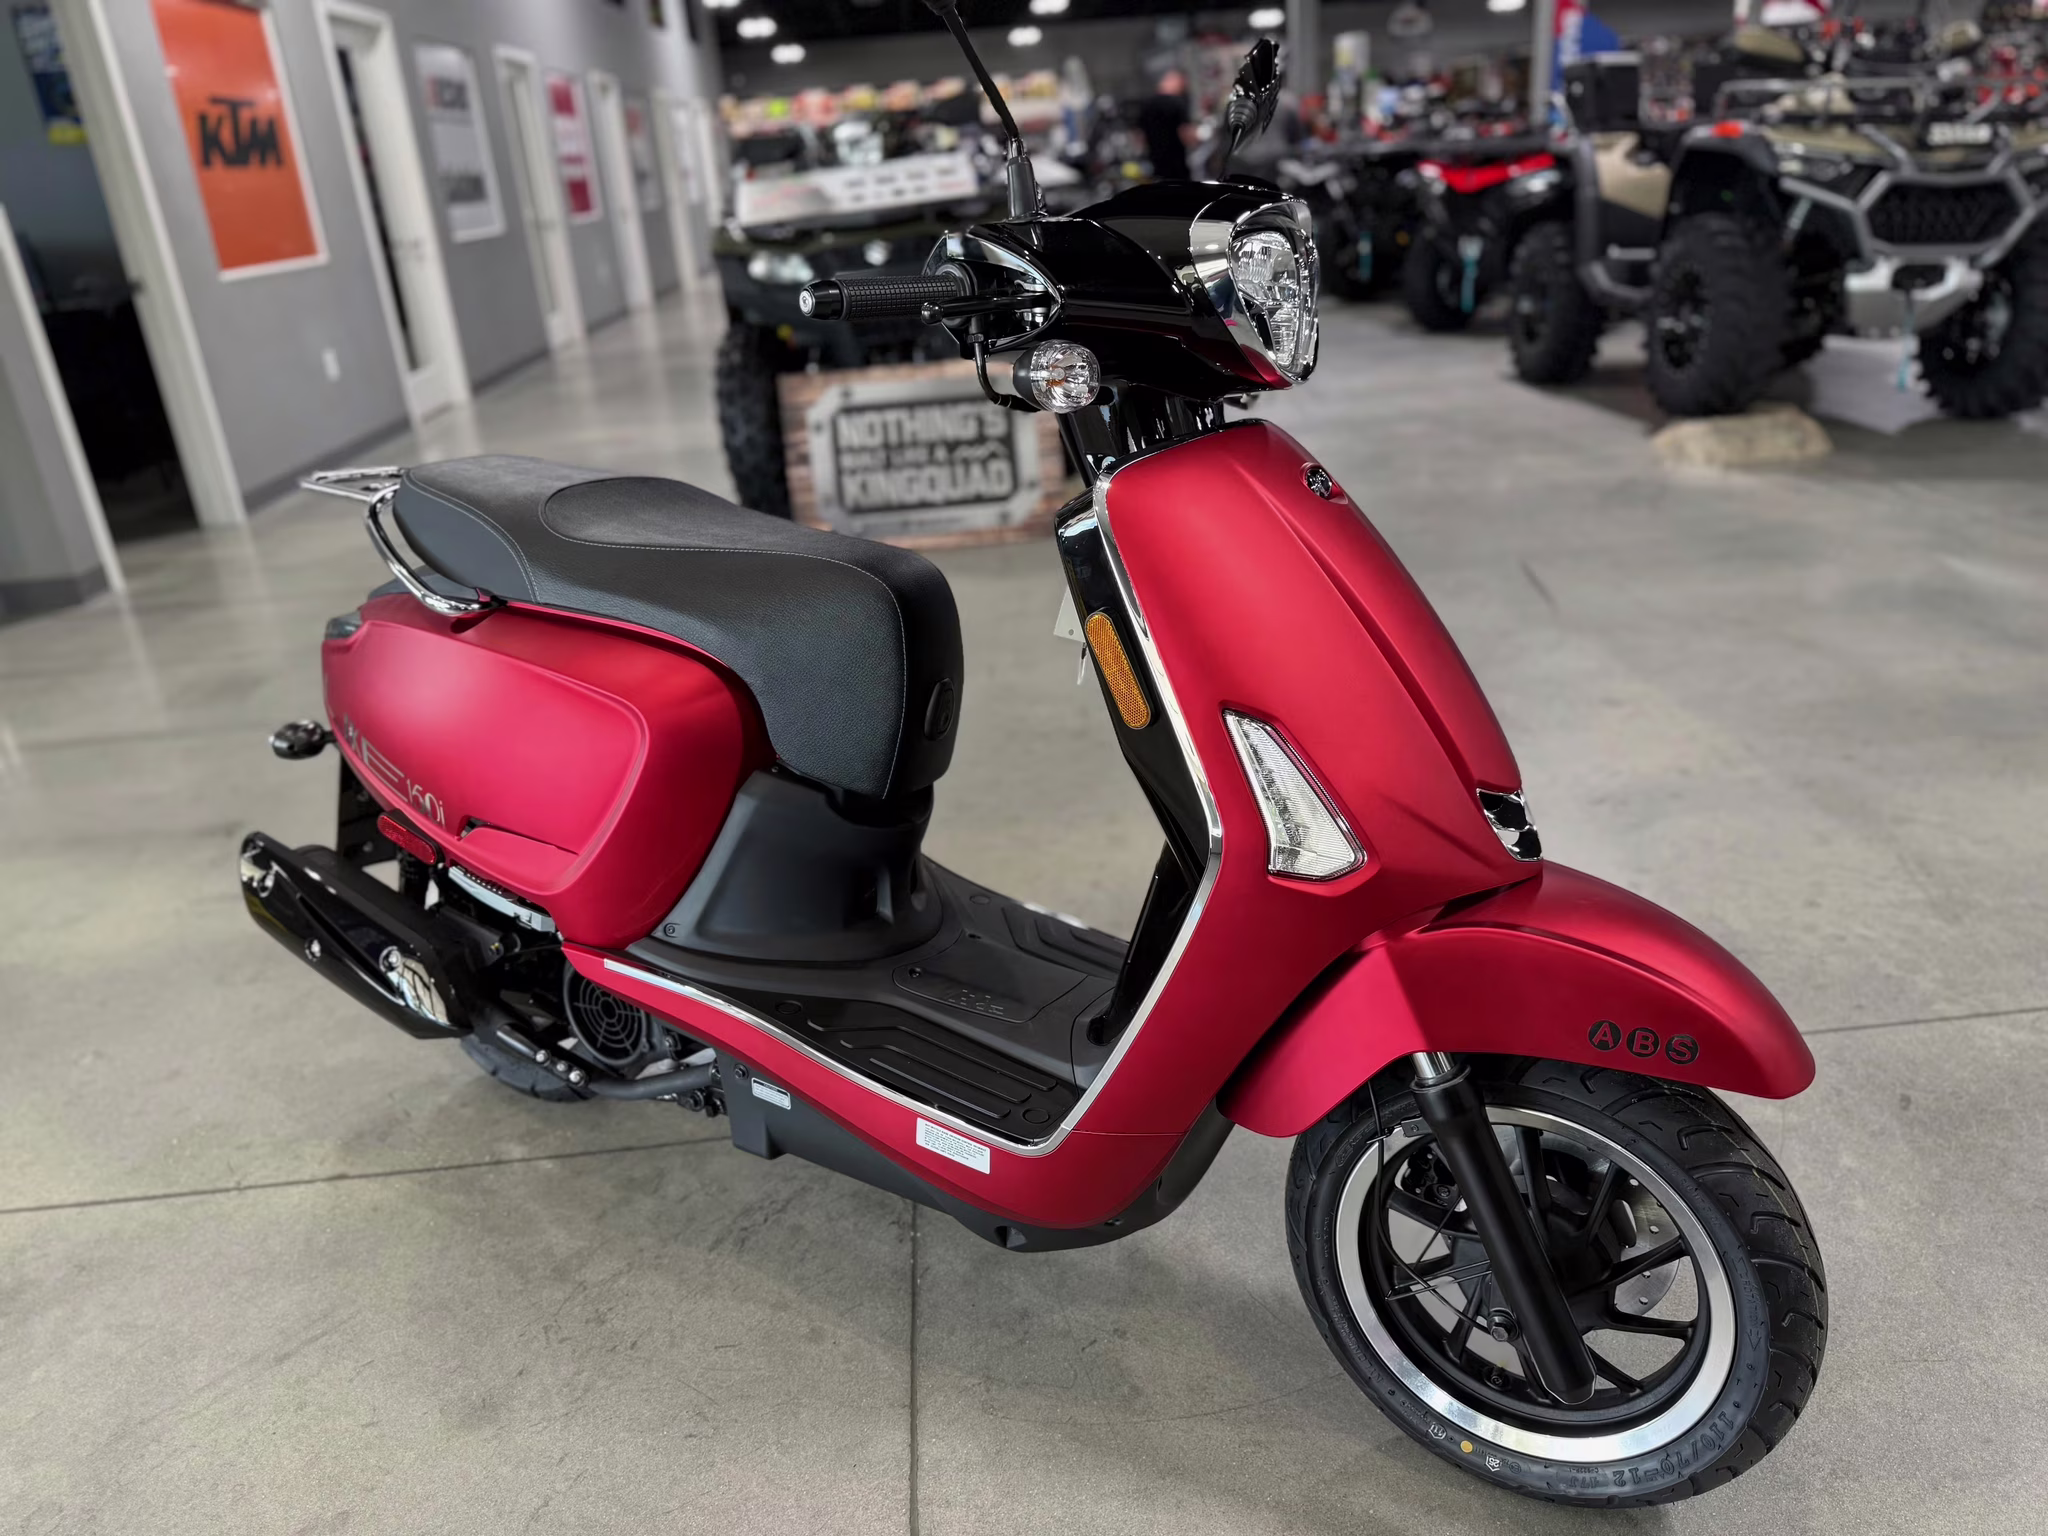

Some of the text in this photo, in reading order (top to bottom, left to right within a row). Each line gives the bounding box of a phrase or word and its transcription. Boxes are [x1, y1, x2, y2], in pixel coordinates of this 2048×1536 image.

[200, 98, 284, 167] KTM
[837, 402, 1008, 448] NOTHING'S
[842, 458, 1013, 508] KINGQUAD
[1590, 1021, 1697, 1062] ABS
[1612, 1411, 1735, 1487] 110/70-12
